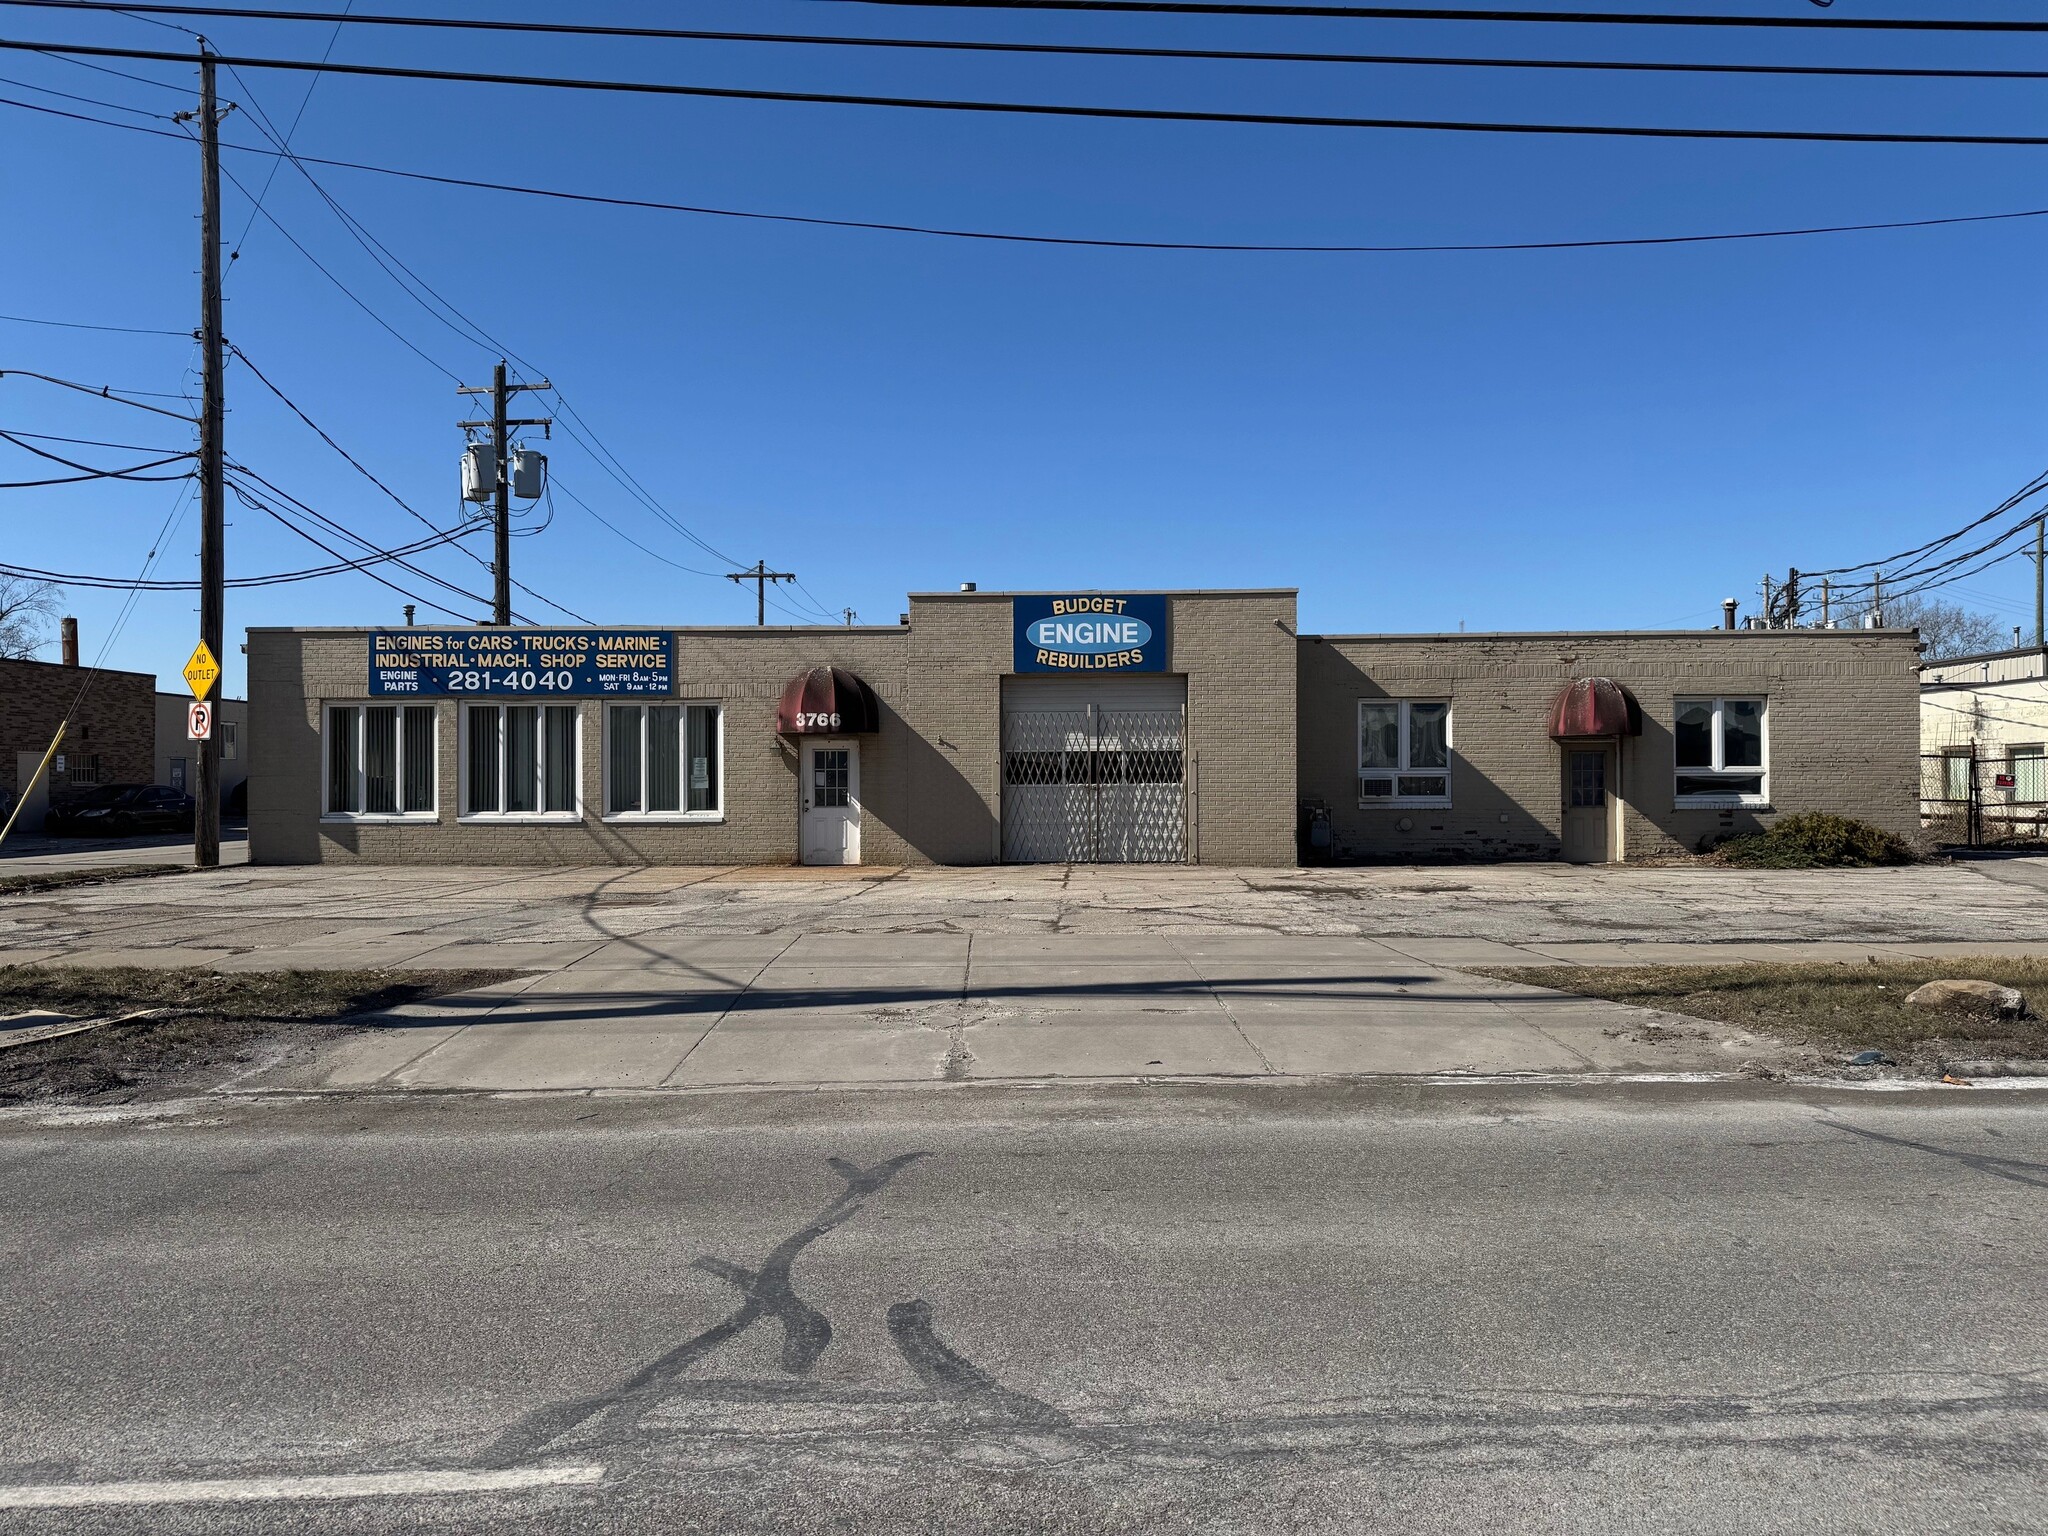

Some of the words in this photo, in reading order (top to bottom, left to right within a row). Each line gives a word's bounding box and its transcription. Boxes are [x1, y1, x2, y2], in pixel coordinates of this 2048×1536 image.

[1052, 597, 1127, 615] BUDGET
[1039, 623, 1138, 644] ENGINE
[375, 636, 444, 651] ENGINES
[446, 636, 465, 650] for
[521, 636, 589, 651] TRUCKS
[598, 636, 660, 651] MARINE
[196, 653, 207, 665] NO
[540, 653, 586, 668] SHOP
[595, 654, 667, 668] SERVICE
[1036, 649, 1144, 669] REBUILDERS
[187, 669, 215, 681] OUTLET
[380, 671, 418, 680] ENGINE
[448, 671, 574, 690] 281-4040
[384, 682, 419, 691] PARTS
[603, 682, 620, 691] SAT
[796, 713, 841, 727] 3766
